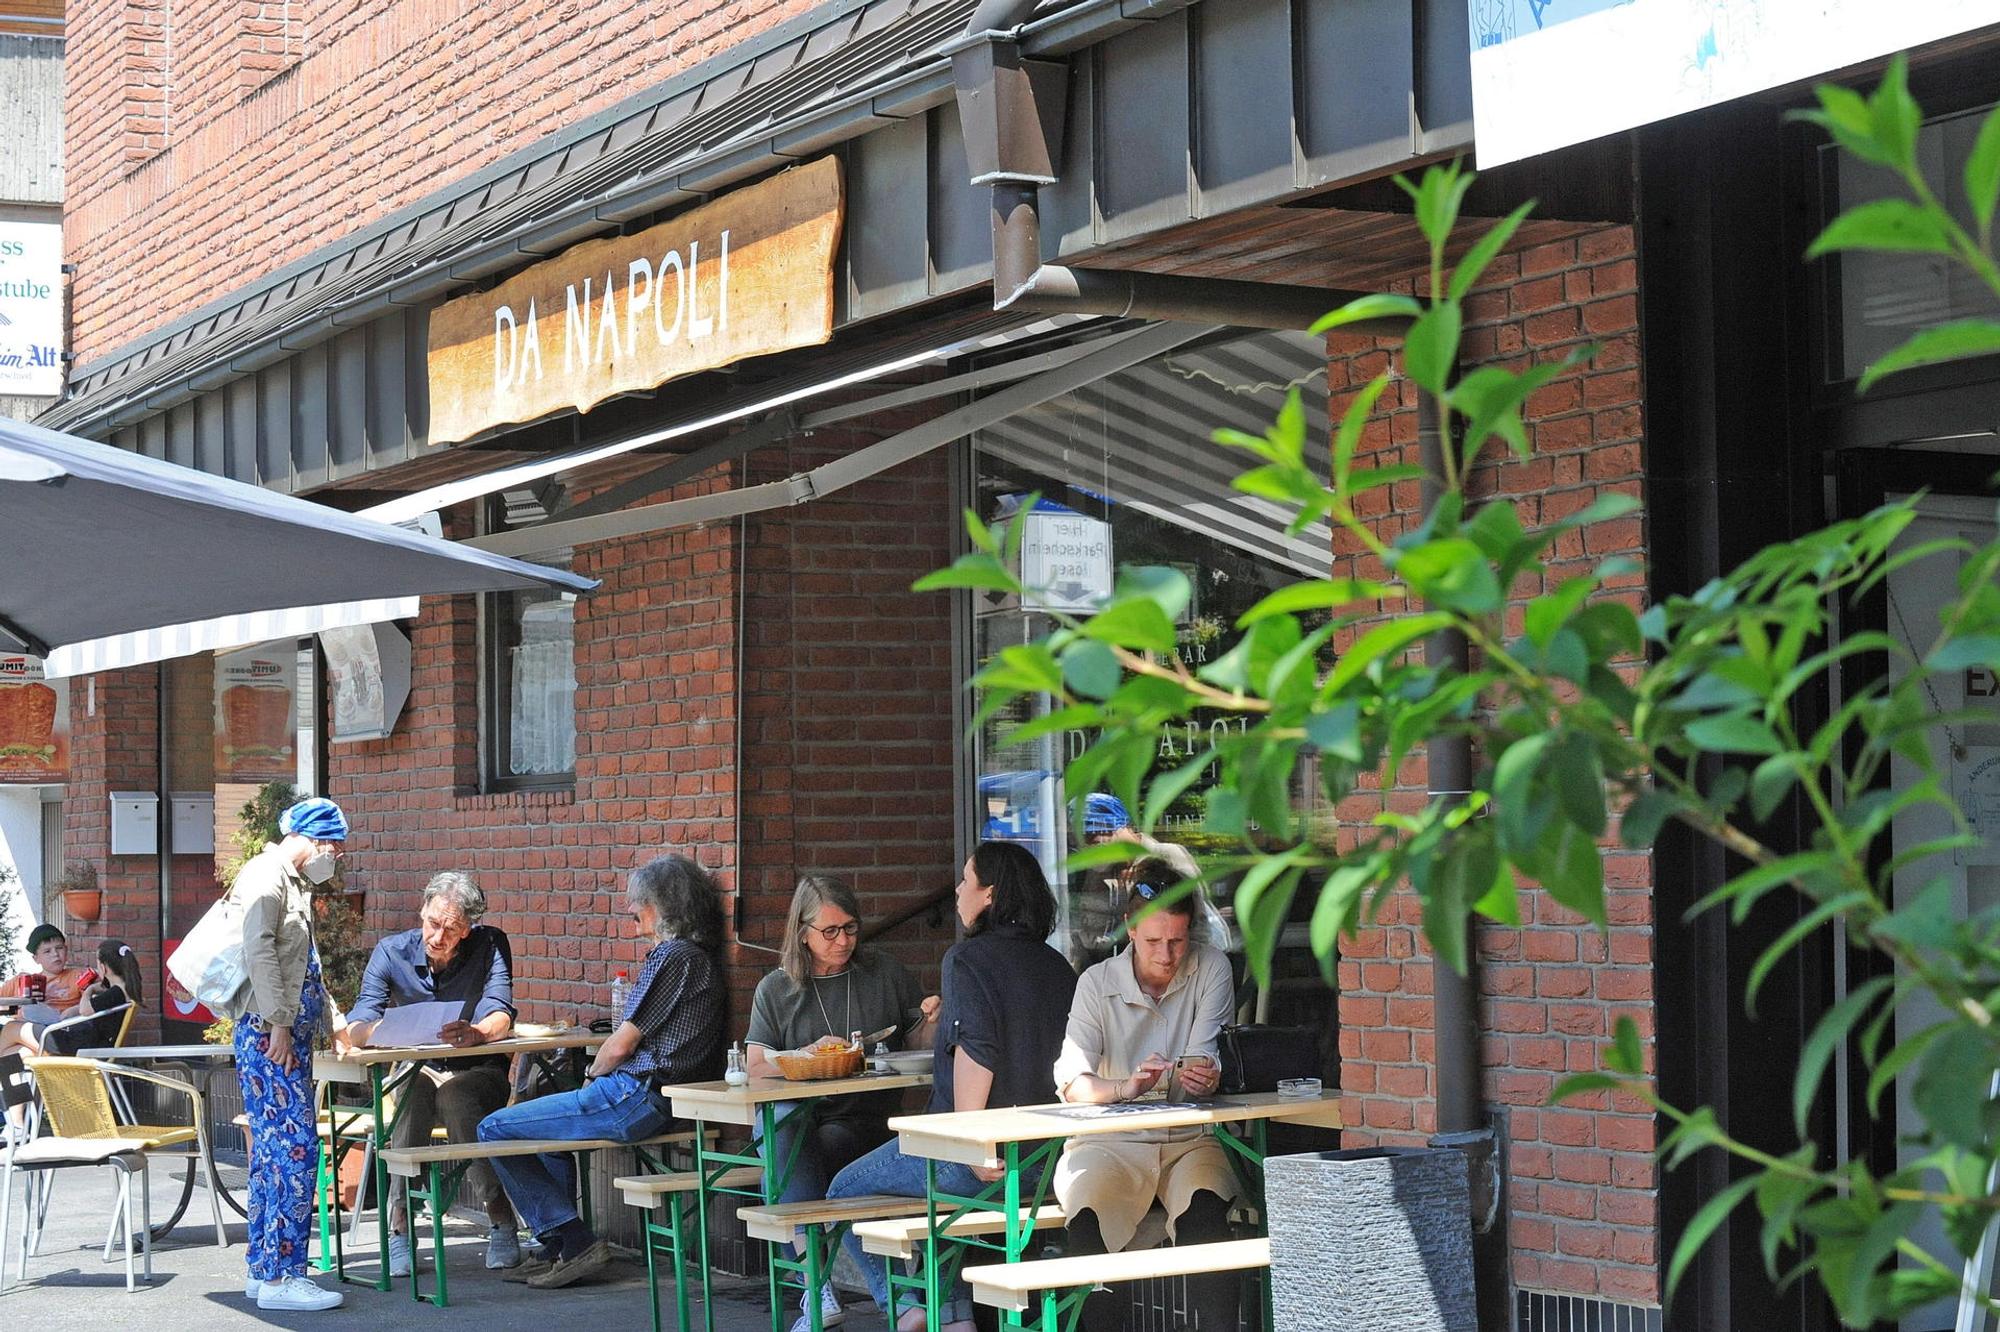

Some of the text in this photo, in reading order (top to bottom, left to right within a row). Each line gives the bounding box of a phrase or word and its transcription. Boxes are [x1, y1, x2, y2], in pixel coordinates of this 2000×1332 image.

[0, 278, 50, 299] tube
[494, 229, 730, 392] DA NAPOLI
[25, 344, 57, 367] Alt
